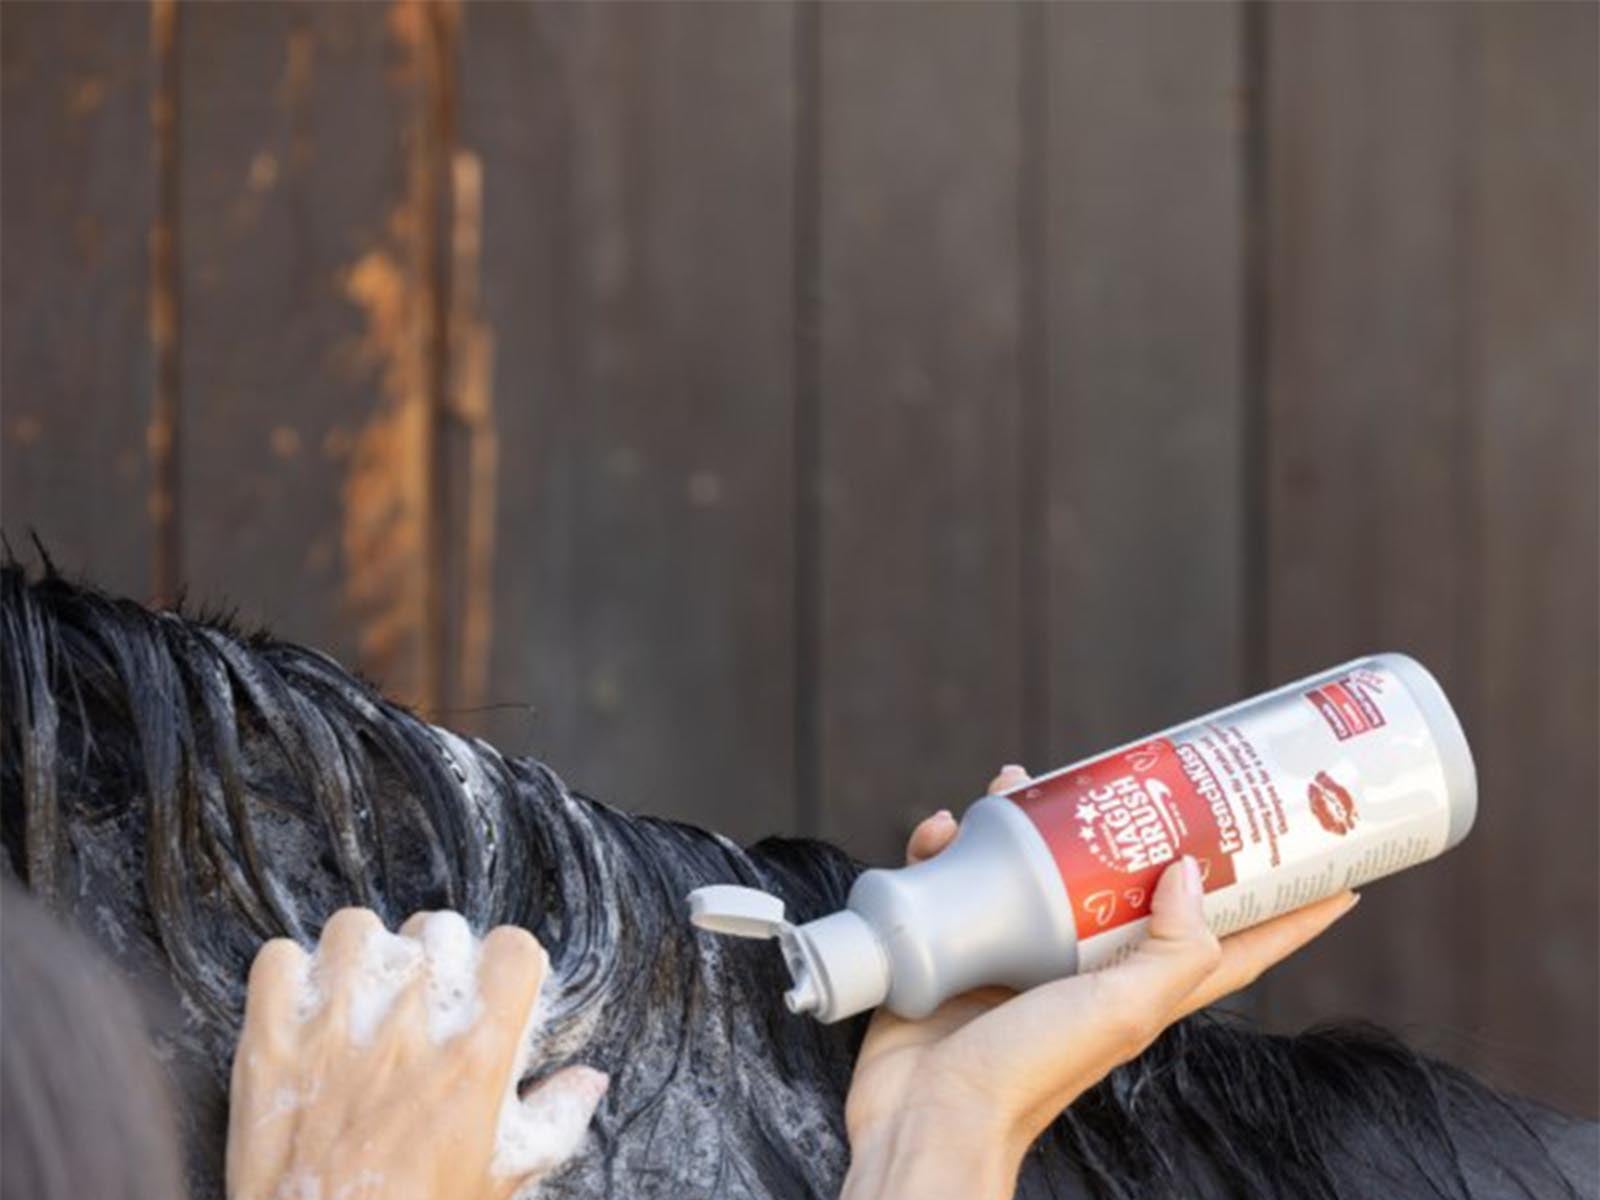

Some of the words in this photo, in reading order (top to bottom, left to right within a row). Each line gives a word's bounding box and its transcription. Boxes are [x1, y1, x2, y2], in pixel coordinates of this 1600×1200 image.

[1088, 783, 1152, 873] MAGIC
[1110, 775, 1174, 865] BRUSH
[1177, 744, 1242, 853] FrenchKiss
